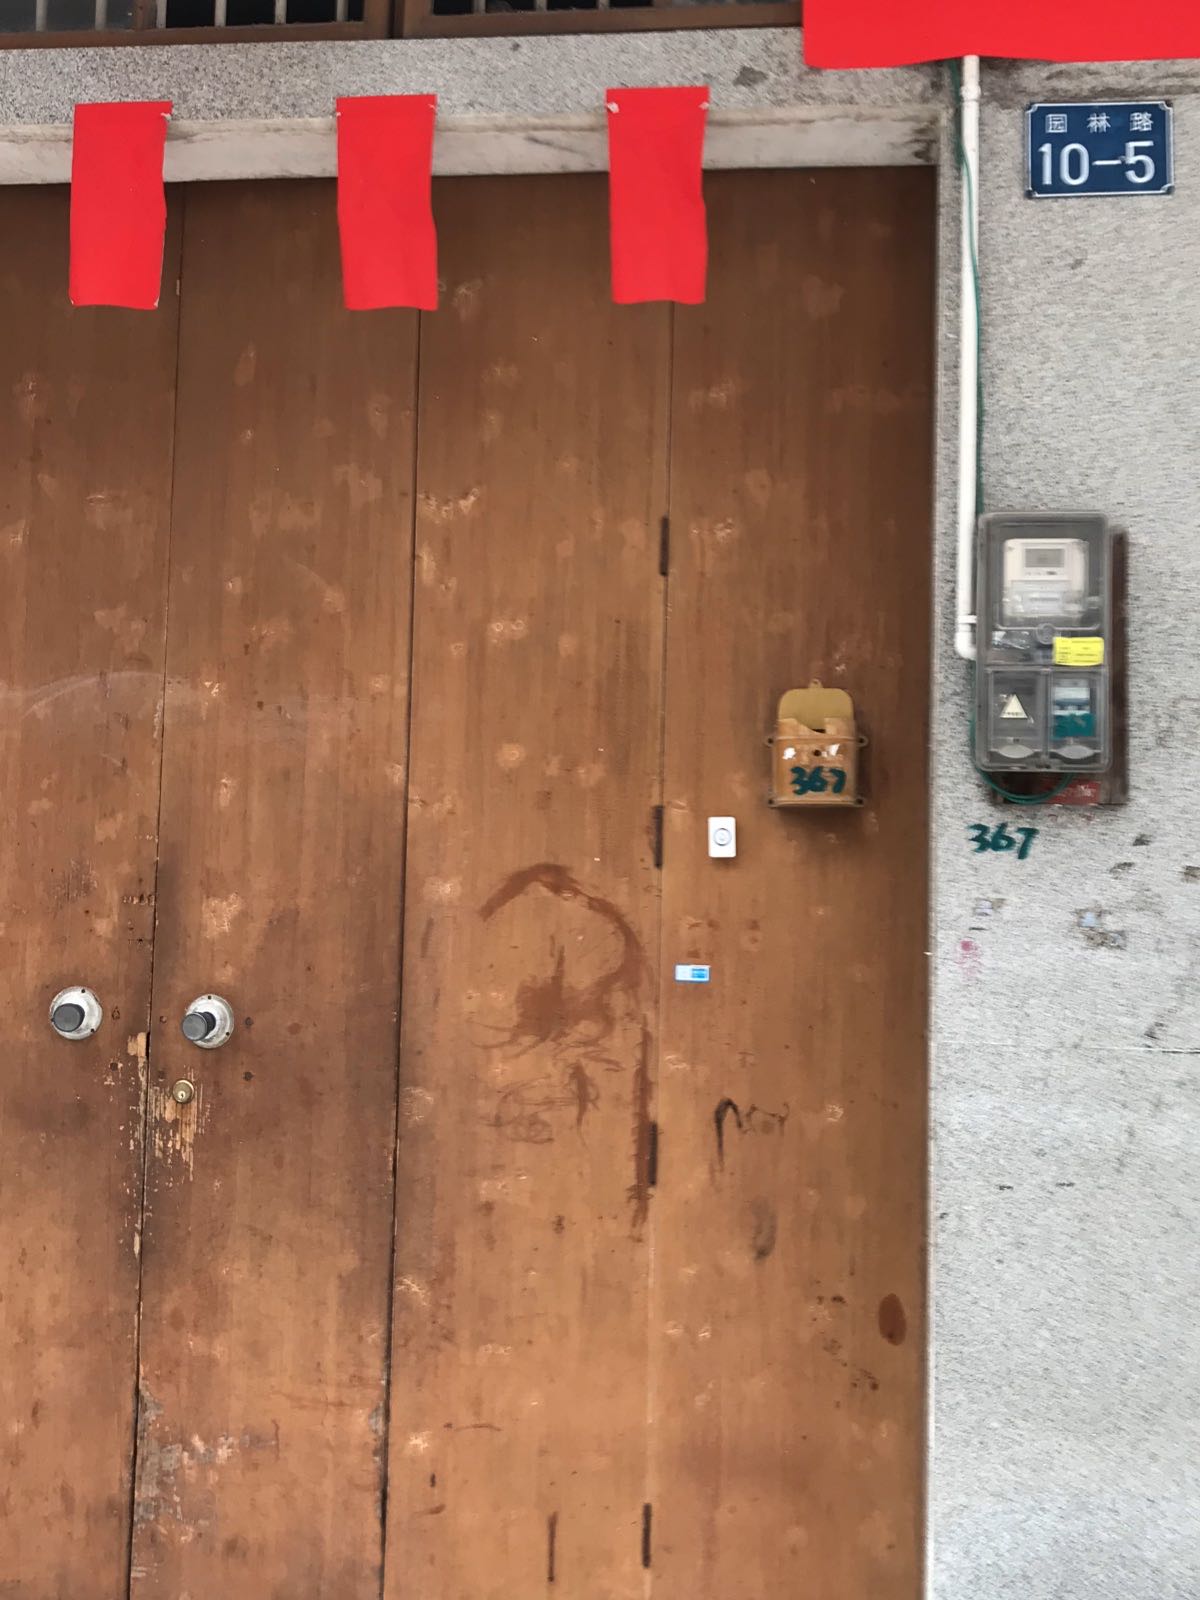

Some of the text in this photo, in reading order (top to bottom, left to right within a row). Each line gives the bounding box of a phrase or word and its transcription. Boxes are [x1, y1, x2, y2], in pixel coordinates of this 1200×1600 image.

[1045, 112, 1154, 133] 园林路
[1038, 140, 1155, 185] 10-5
[790, 765, 847, 795] 367
[967, 822, 1039, 860] 367
